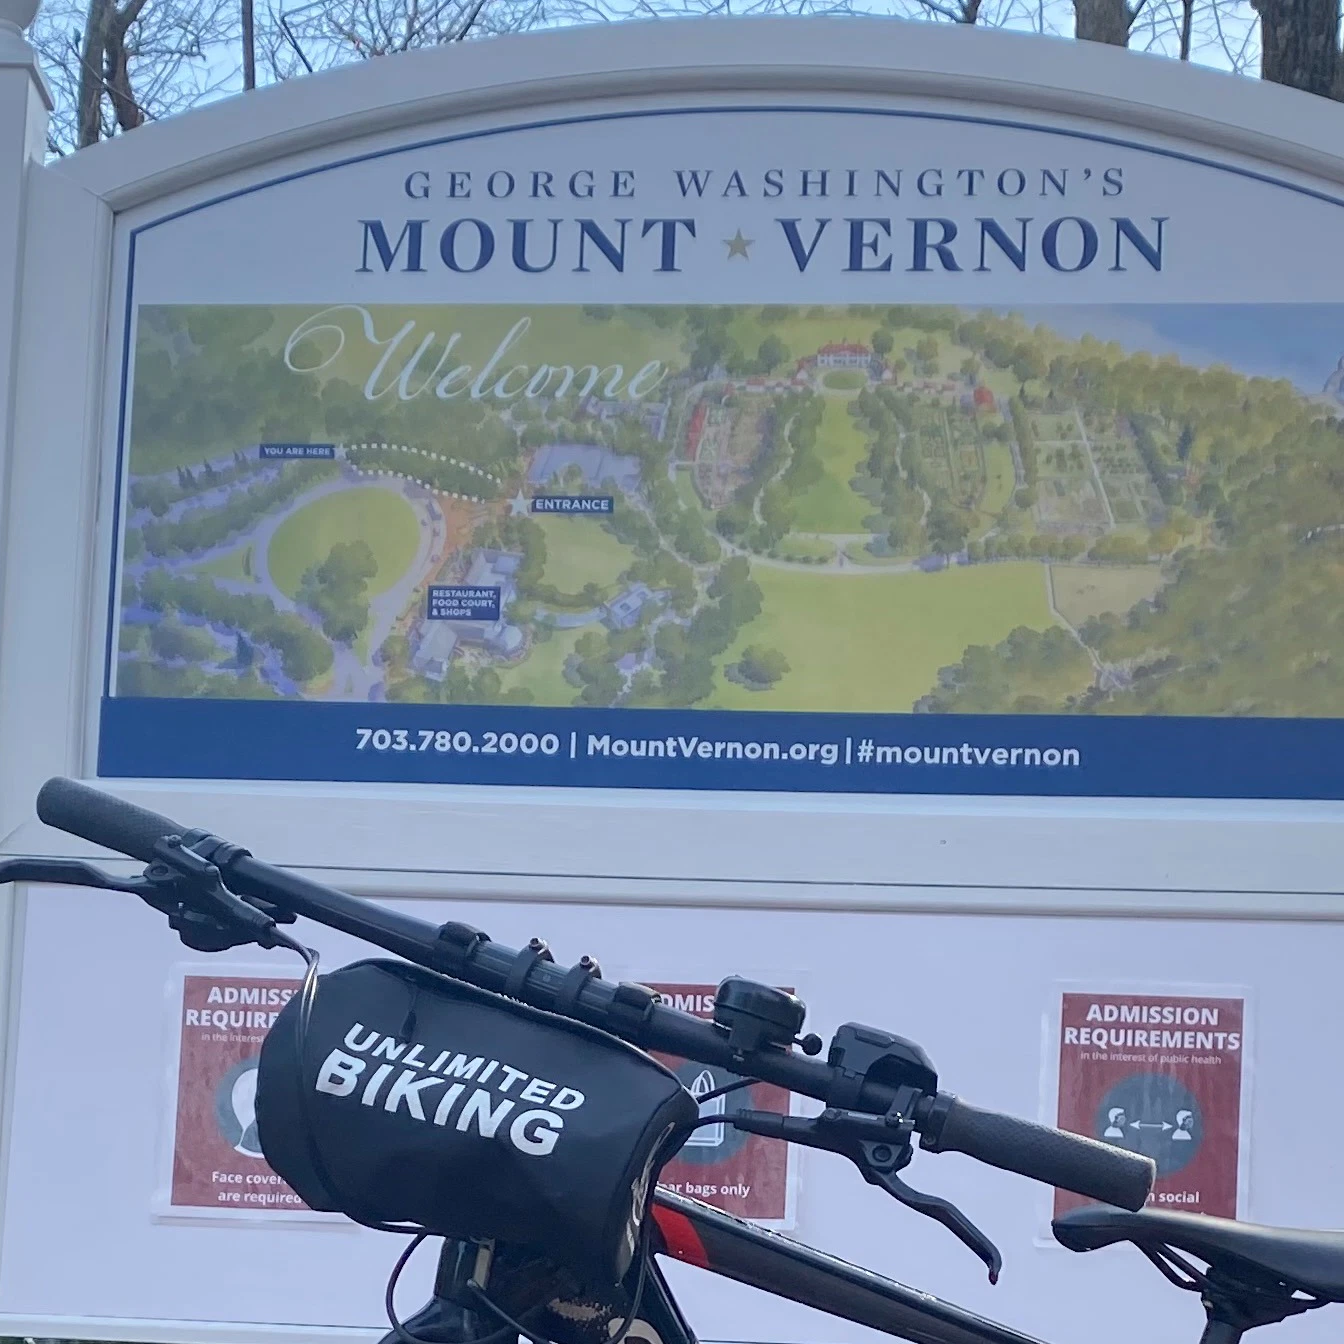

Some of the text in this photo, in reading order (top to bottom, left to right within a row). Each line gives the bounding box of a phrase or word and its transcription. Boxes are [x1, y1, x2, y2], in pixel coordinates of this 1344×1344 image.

[404, 168, 1127, 200] GEORGE WASHINGTON'S
[354, 216, 1170, 275] MOUNT VERNON
[284, 304, 669, 401] Welcome
[264, 446, 331, 456] YOU ARE HERE
[535, 498, 609, 511] ENTRANCE
[431, 598, 459, 608] FOOD
[439, 608, 472, 617] SHOPS
[355, 728, 560, 755] 703.780.2000
[207, 986, 299, 1007] ADMISS
[185, 1008, 280, 1031] REQUIRE
[1086, 1003, 1219, 1026] ADMISSION
[1064, 1027, 1241, 1051] REQUIREMENTS
[344, 1022, 586, 1111] UNLIMITED
[1080, 1050, 1222, 1066] in the interest of public health
[315, 1048, 564, 1156] BIKING
[211, 1171, 287, 1185] Face cover
[217, 1192, 241, 1202] are
[685, 1181, 717, 1198] bags
[720, 1183, 751, 1199] only
[1158, 1190, 1200, 1204] social
